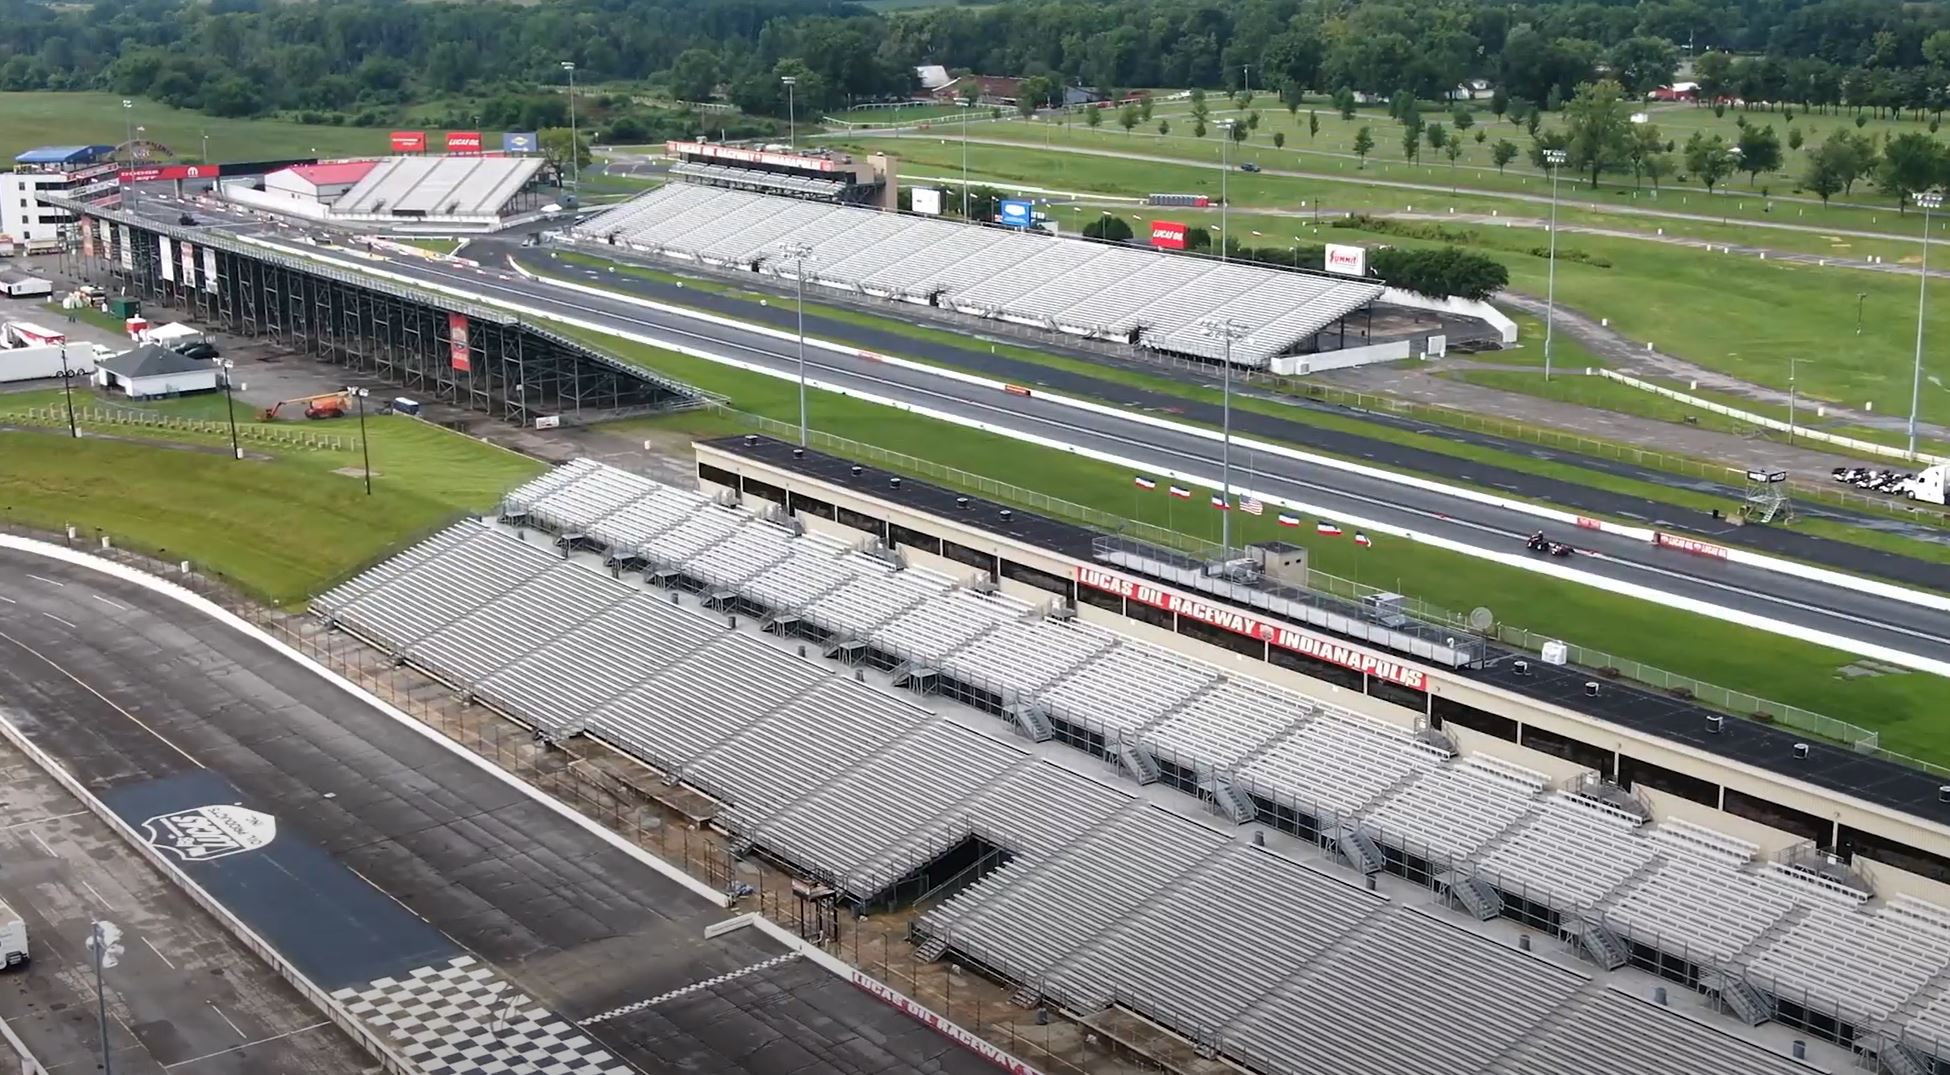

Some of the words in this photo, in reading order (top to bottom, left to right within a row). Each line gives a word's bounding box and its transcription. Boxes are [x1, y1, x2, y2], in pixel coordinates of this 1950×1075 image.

[449, 138, 469, 146] LUCAS
[1153, 229, 1173, 239] LUCAS
[1080, 568, 1134, 597] LUCAS
[1138, 587, 1165, 606] OIL
[1168, 595, 1257, 634] RACEWAY
[1278, 630, 1424, 687] INDIANAPOLIS
[853, 971, 903, 1007] LUCAS
[908, 1002, 934, 1024] OIL
[936, 1018, 1018, 1071] RACEWAY
